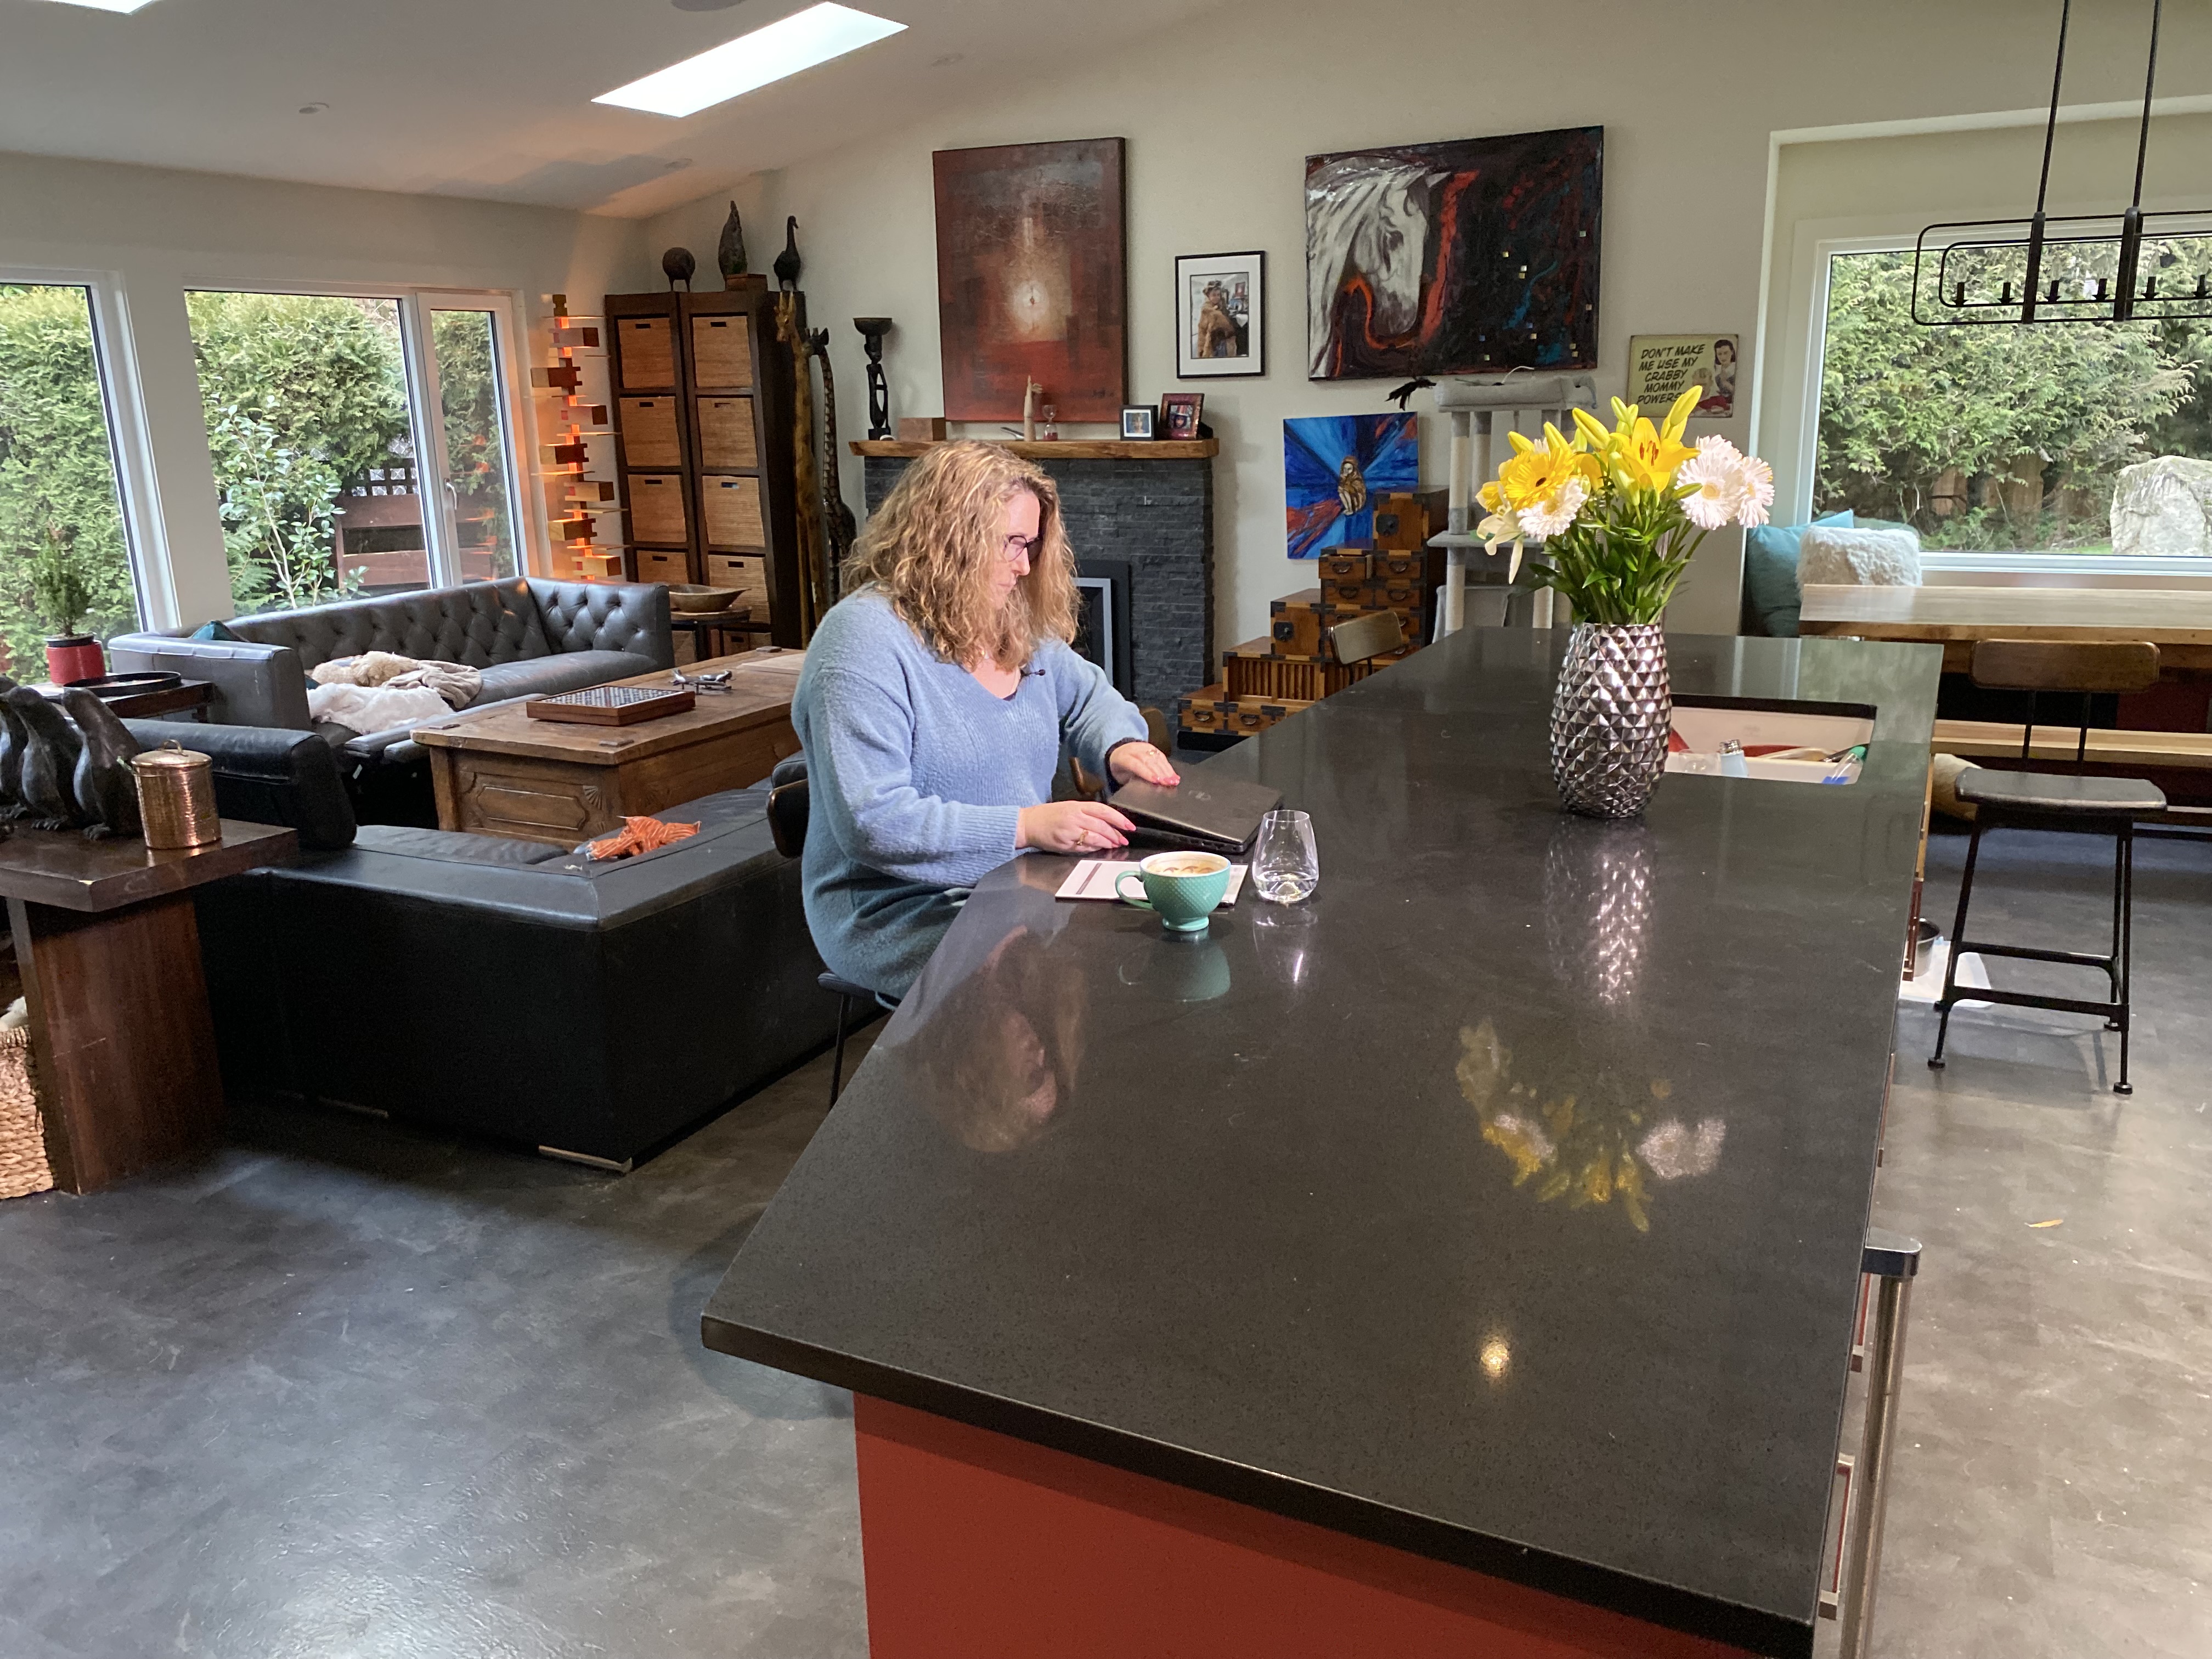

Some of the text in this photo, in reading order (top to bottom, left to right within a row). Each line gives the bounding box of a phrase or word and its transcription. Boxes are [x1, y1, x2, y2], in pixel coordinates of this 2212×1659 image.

[1641, 344, 1706, 359] DON'T MAKE
[1638, 357, 1699, 371] ME USE MY
[1645, 369, 1688, 382] CRABBY
[1644, 380, 1685, 393] MOMMY
